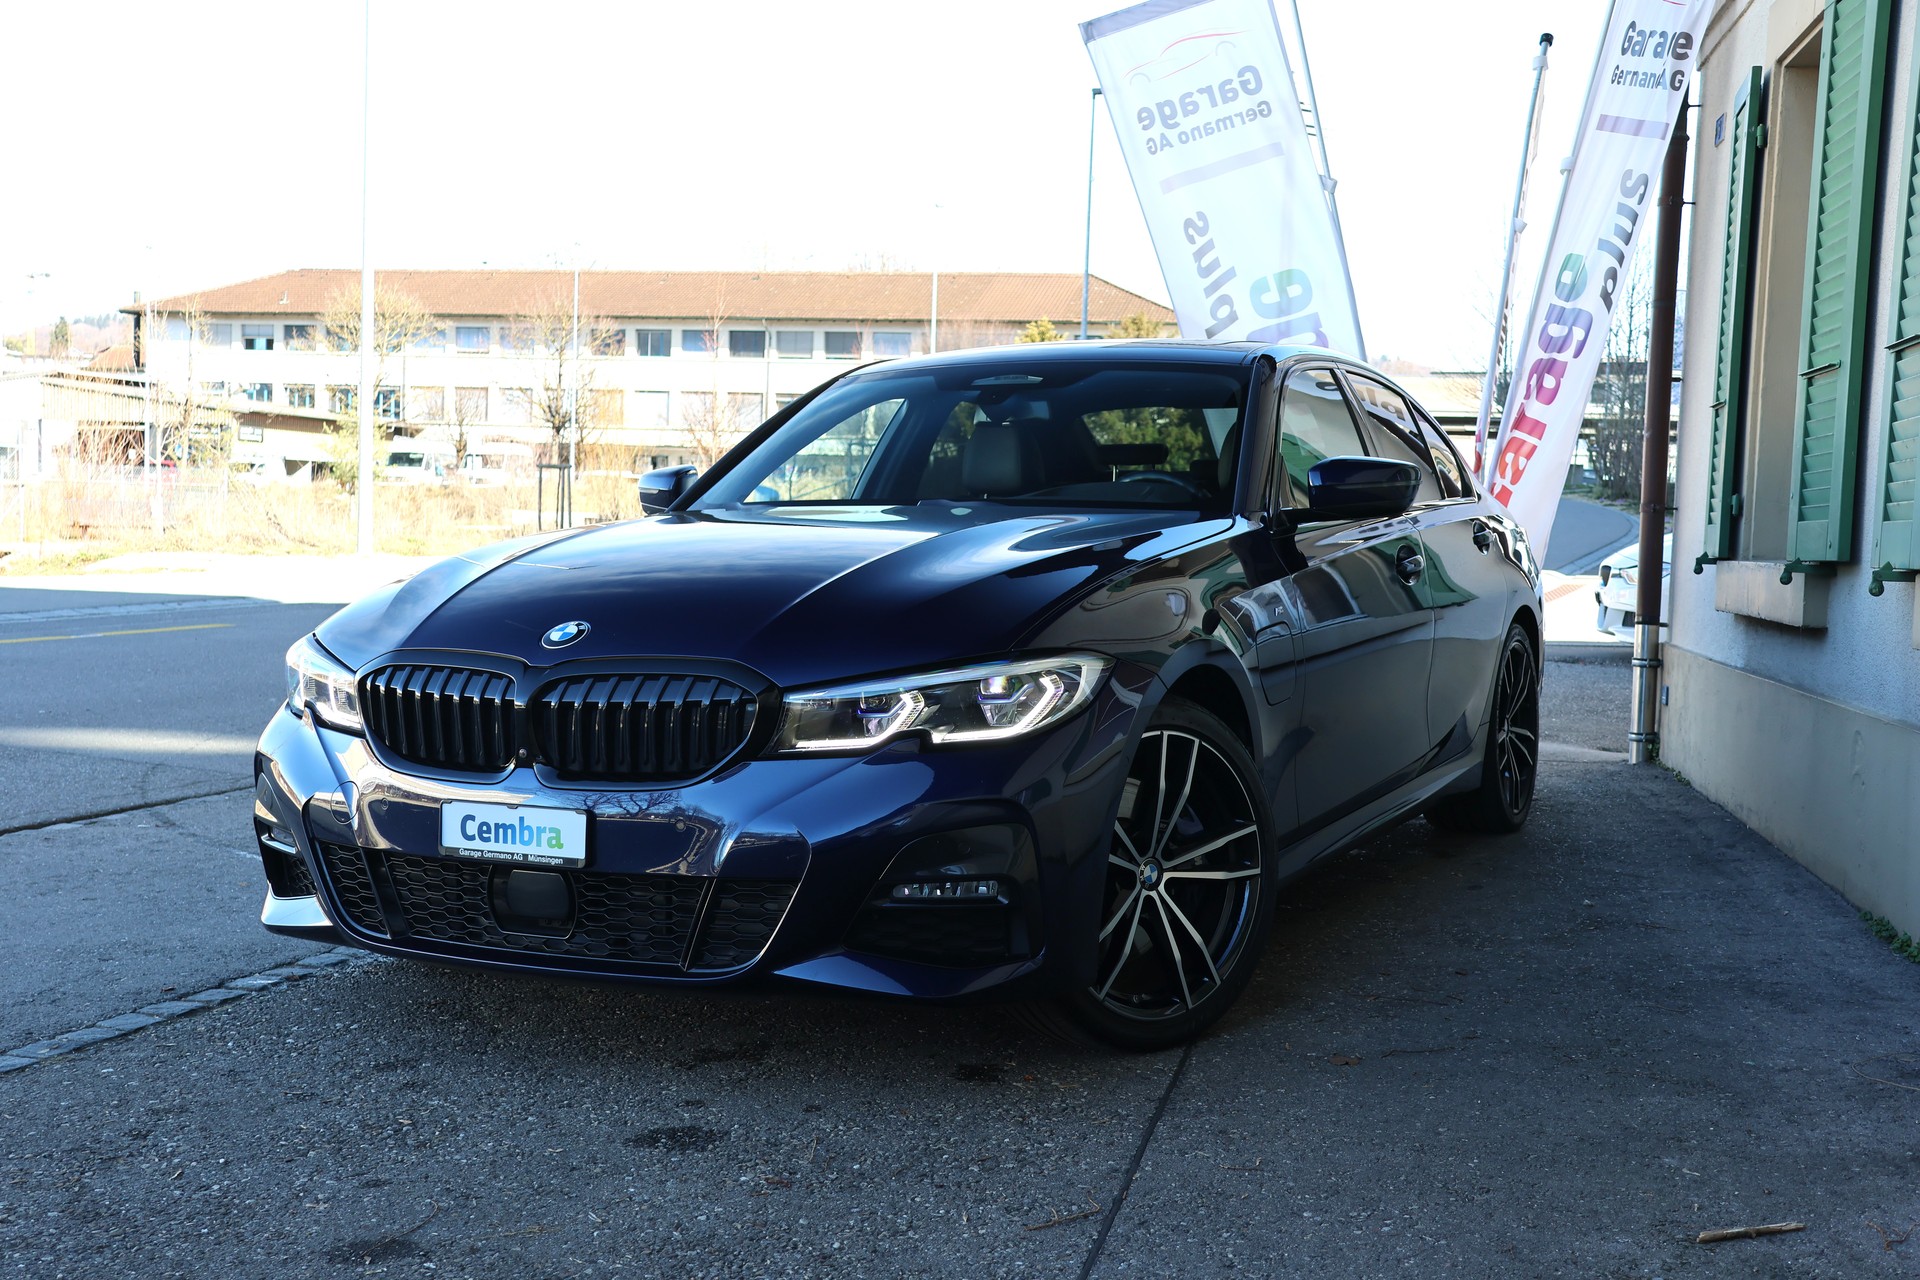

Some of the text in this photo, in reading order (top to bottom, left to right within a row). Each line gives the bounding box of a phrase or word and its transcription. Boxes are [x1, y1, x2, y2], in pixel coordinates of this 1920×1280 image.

[1598, 169, 1649, 314] plus
[460, 813, 564, 850] Cembra
[459, 848, 564, 865] Garage Germano AG Münsingen
